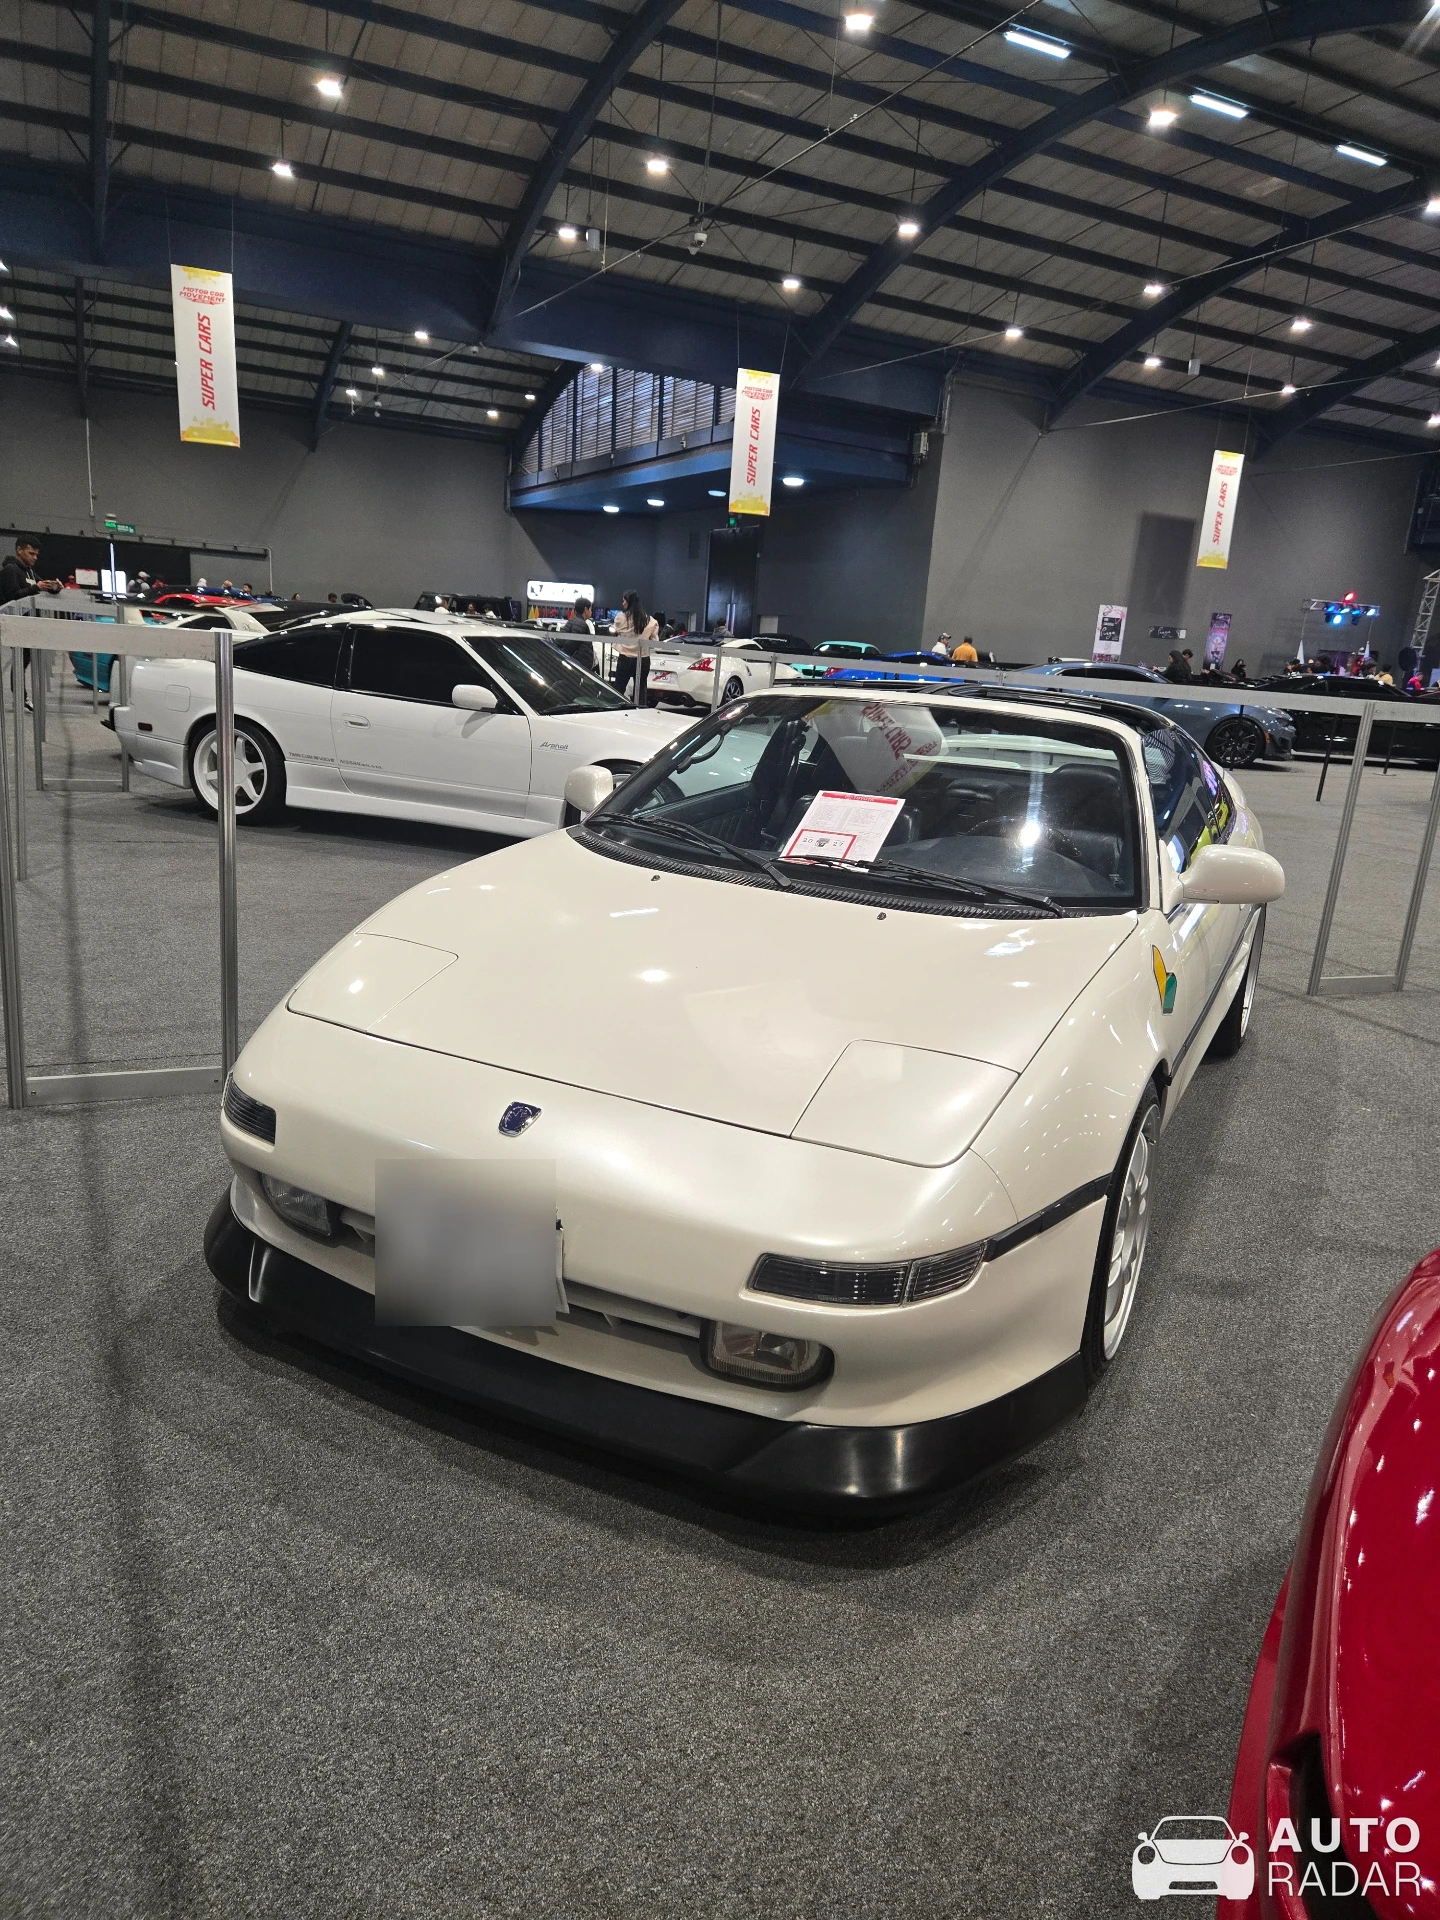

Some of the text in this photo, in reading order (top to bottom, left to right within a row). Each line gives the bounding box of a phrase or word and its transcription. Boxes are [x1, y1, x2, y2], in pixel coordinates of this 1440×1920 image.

[179, 291, 226, 303] MOVEMENT
[183, 286, 208, 295] MOTOR
[197, 312, 212, 355] CARS
[200, 358, 215, 411] SUPER
[746, 406, 761, 486] SUPER CARS
[1212, 511, 1224, 545] SUPER
[1218, 481, 1228, 508] CARS
